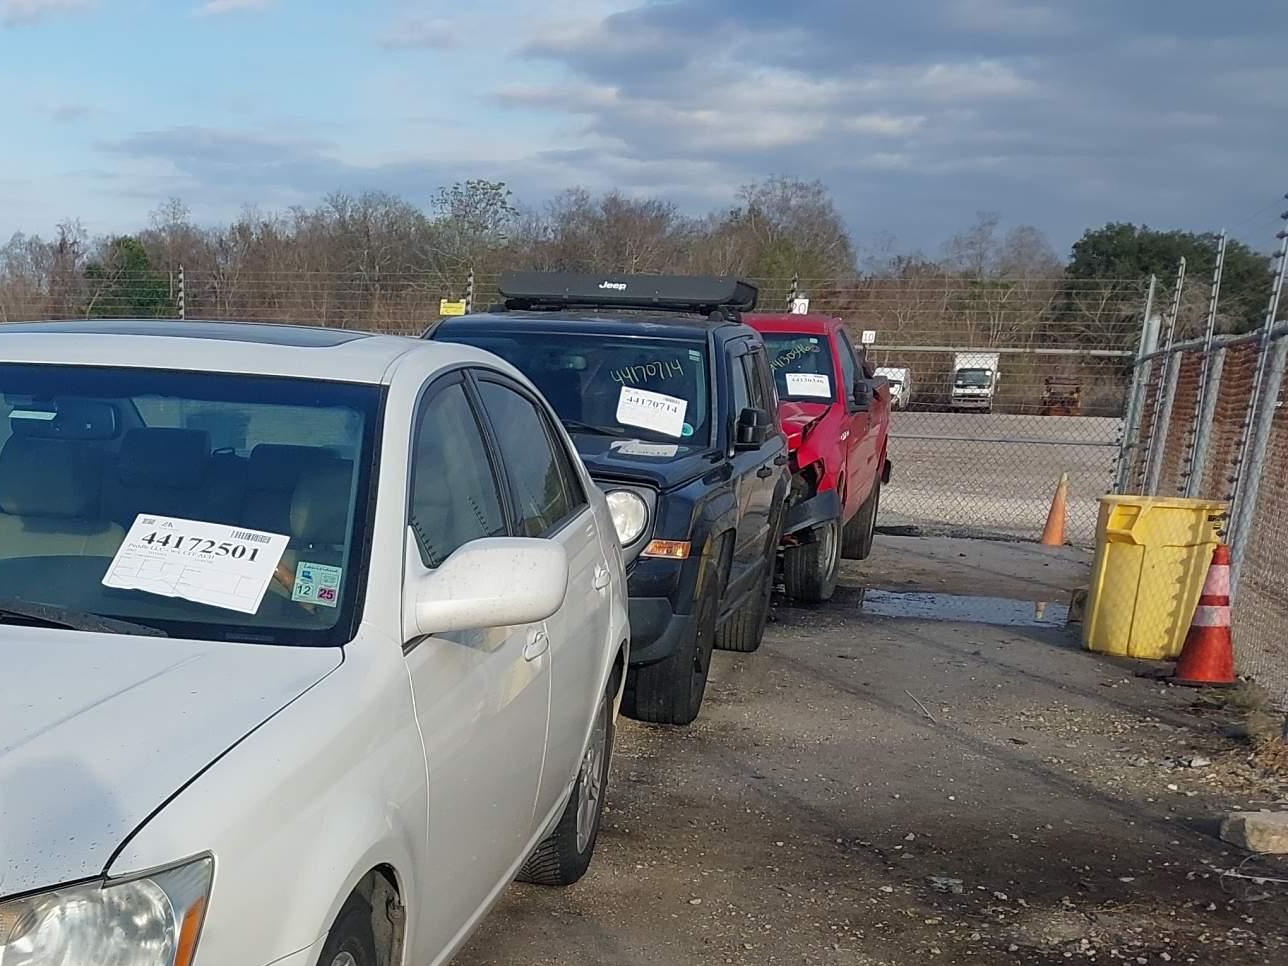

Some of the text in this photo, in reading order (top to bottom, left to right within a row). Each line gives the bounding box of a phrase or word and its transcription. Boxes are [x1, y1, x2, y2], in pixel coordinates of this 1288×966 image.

[598, 280, 627, 291] Jeep
[610, 358, 684, 385] 44170714
[626, 395, 678, 413] 44170714
[141, 530, 261, 563] 44172501
[297, 585, 334, 600] 12 25
